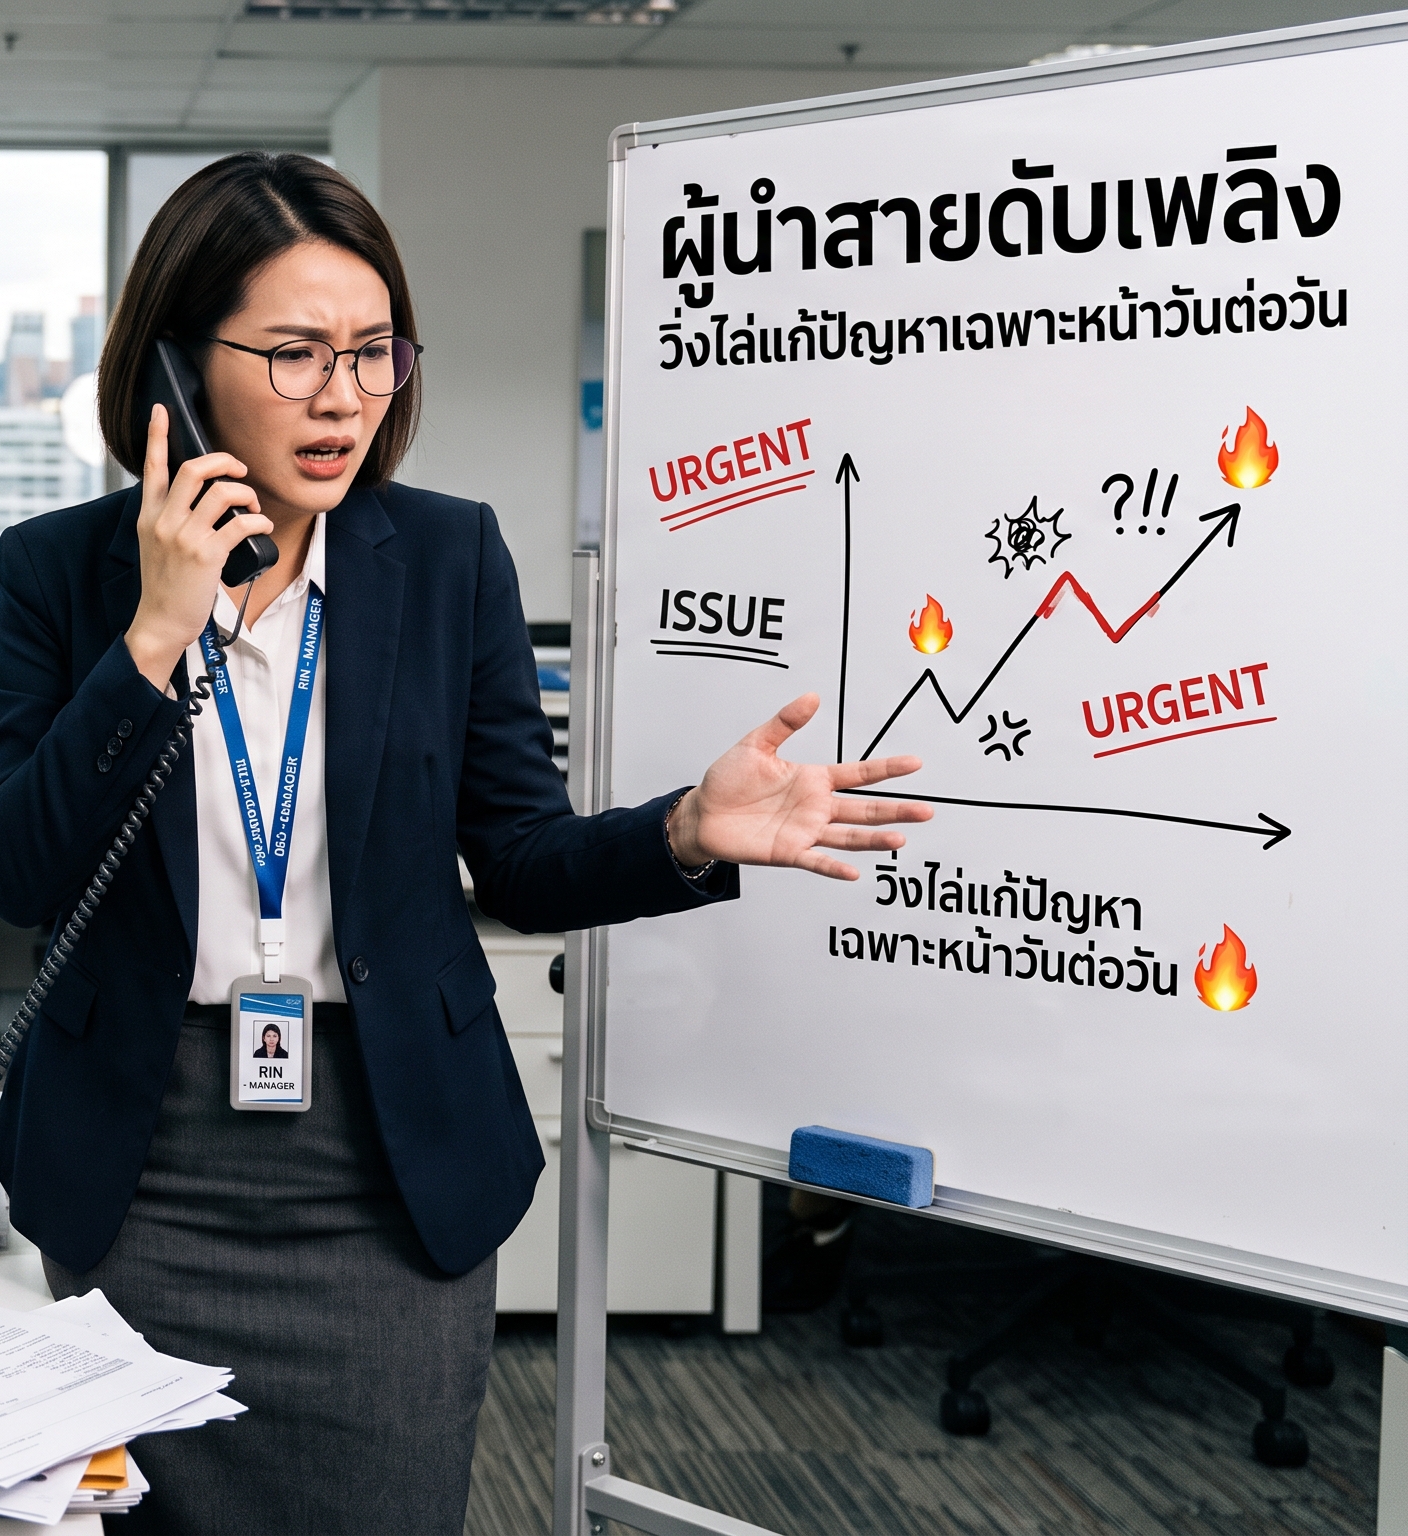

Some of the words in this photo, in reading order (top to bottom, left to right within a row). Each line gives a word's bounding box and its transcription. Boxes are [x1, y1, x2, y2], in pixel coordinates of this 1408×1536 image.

[662, 144, 1341, 309] ผู้นำสายดับเพลิง
[658, 275, 1347, 370] วิ่งไล่แก้ปัญหาเฉพาะหน้าวันต่อวัน
[648, 417, 812, 503] URGENT
[302, 597, 323, 660] MANAGER
[659, 588, 785, 641] ISSUE
[297, 669, 311, 690] RIN
[1081, 661, 1269, 739] URGENT
[875, 850, 1142, 935] วิ่งไล่แก้ปัญหา
[829, 925, 1179, 997] เฉพาะหน้าวันต่อวัน
[249, 1081, 295, 1090] MANAGER
[259, 1065, 283, 1079] RIN
